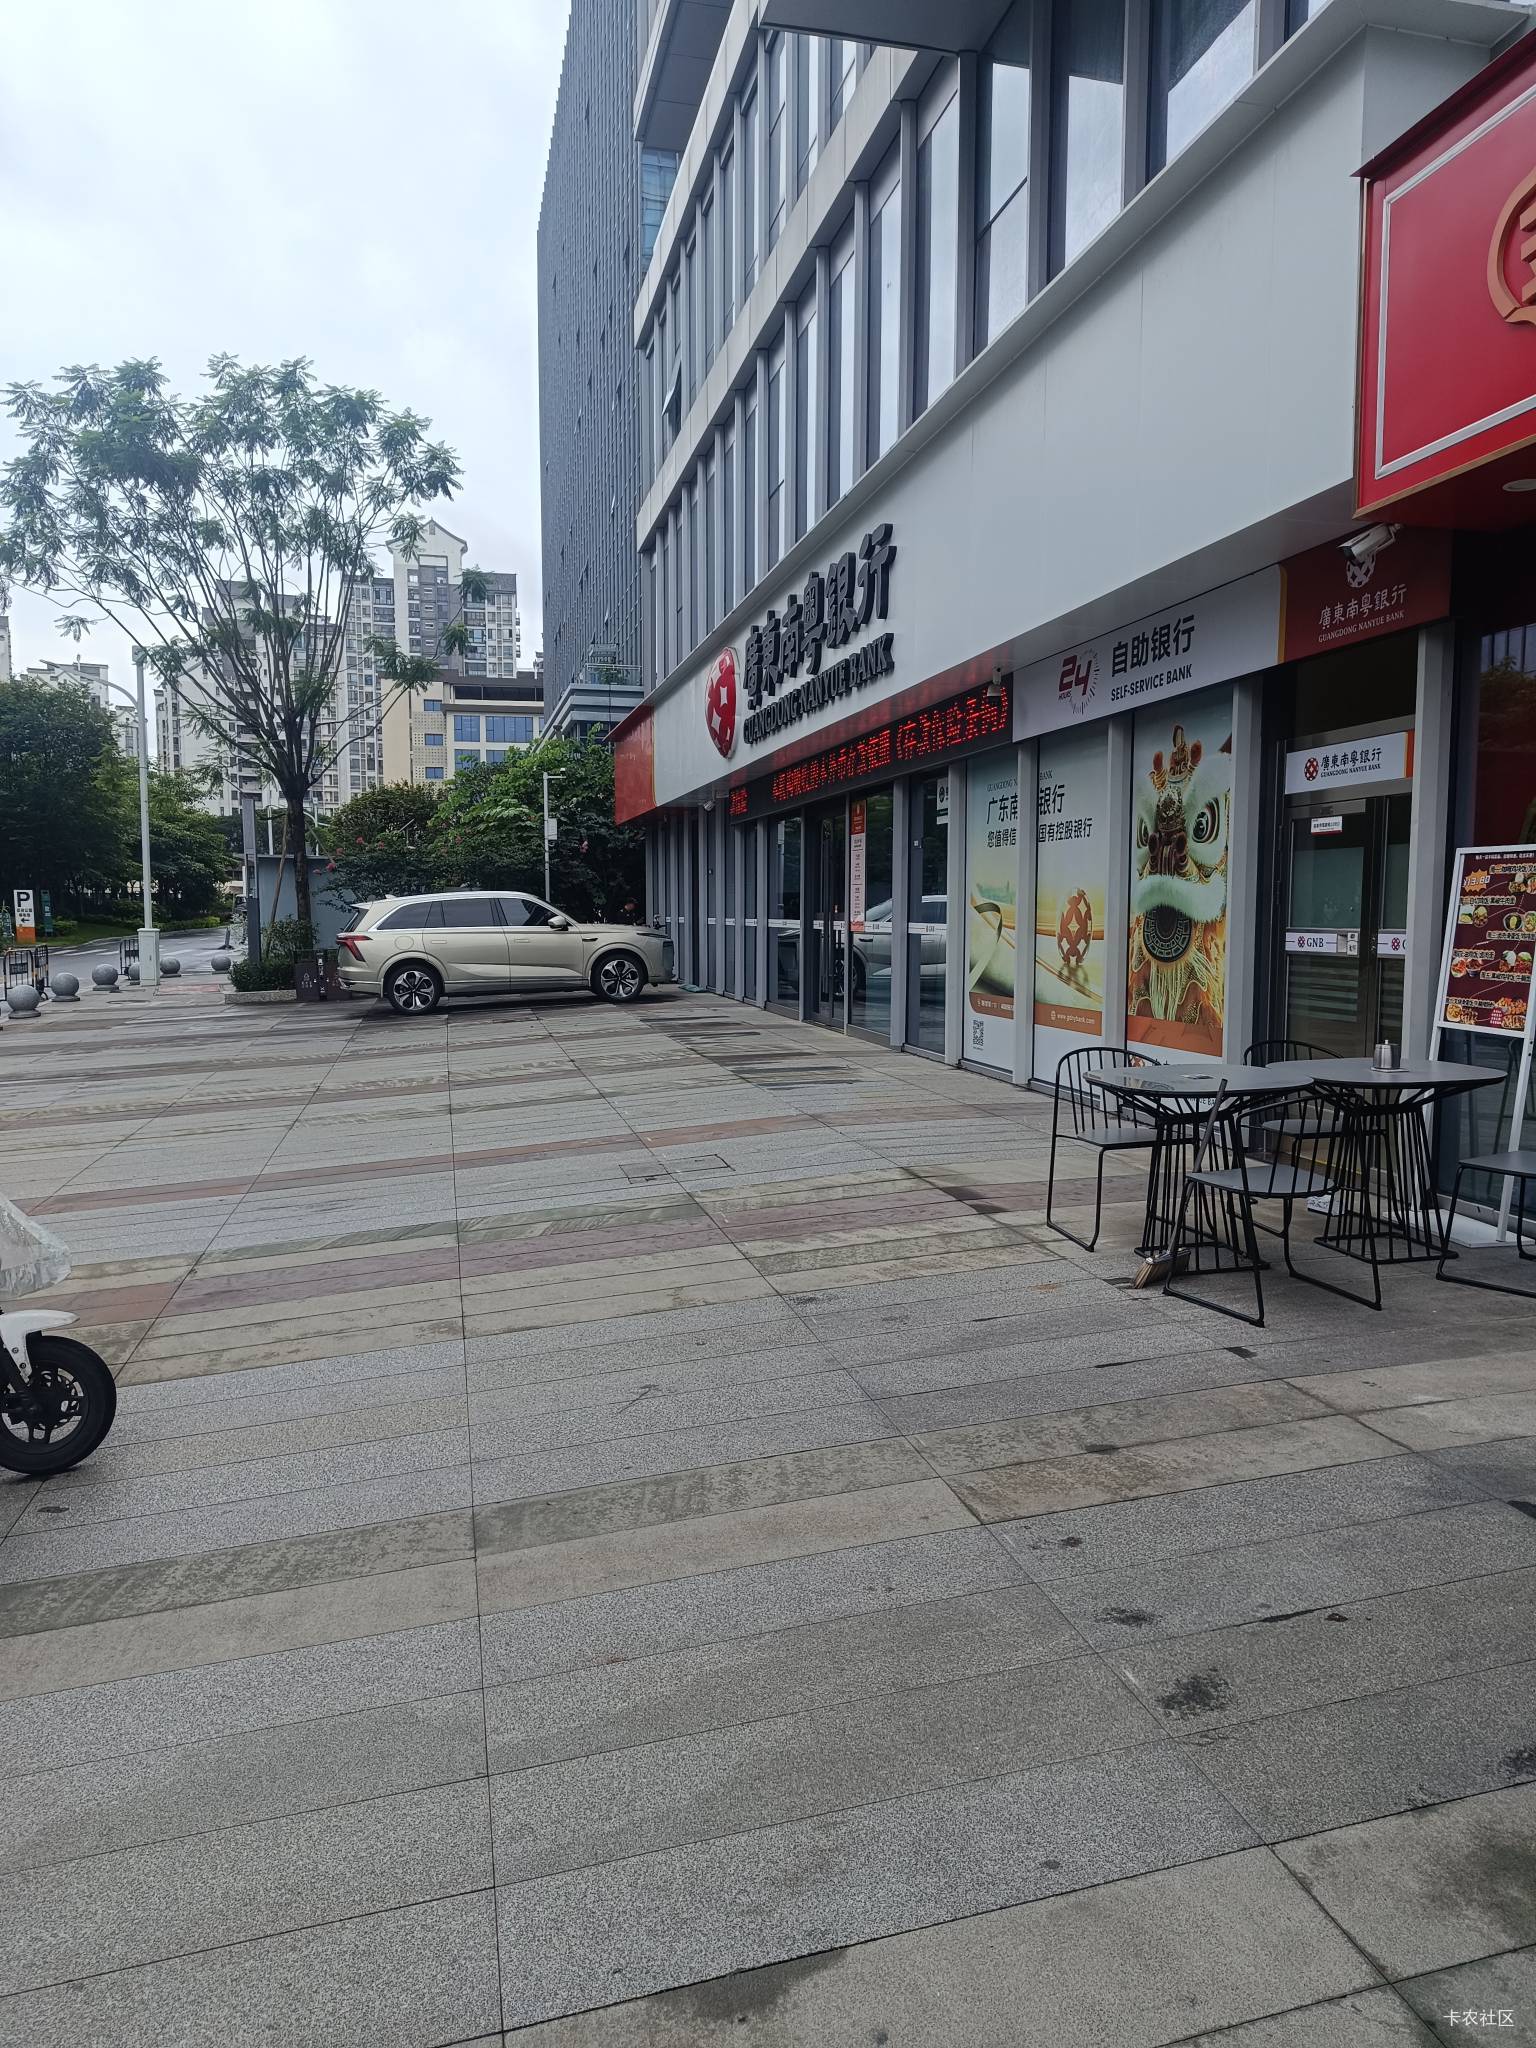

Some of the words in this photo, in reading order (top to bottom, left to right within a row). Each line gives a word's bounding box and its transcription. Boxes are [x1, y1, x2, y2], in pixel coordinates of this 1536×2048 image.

[1318, 624, 1358, 643] GUANGDONG
[1358, 616, 1385, 631] NANYUE
[1386, 610, 1405, 623] BANK
[1111, 614, 1195, 677] 自助银行
[743, 688, 801, 745] GUANGDONG
[799, 658, 850, 713] NANYUE
[849, 632, 895, 688] BANK
[1058, 654, 1093, 697] 24
[1111, 672, 1164, 702] SELF-SERVICE
[1166, 663, 1193, 685] BANK
[986, 780, 1014, 792] GUANGDONG
[1320, 769, 1349, 778] GUANGDONG
[1349, 765, 1368, 774] NANYUE
[1368, 763, 1381, 771] BANK
[16, 891, 31, 908] P
[1306, 937, 1324, 948] GNB
